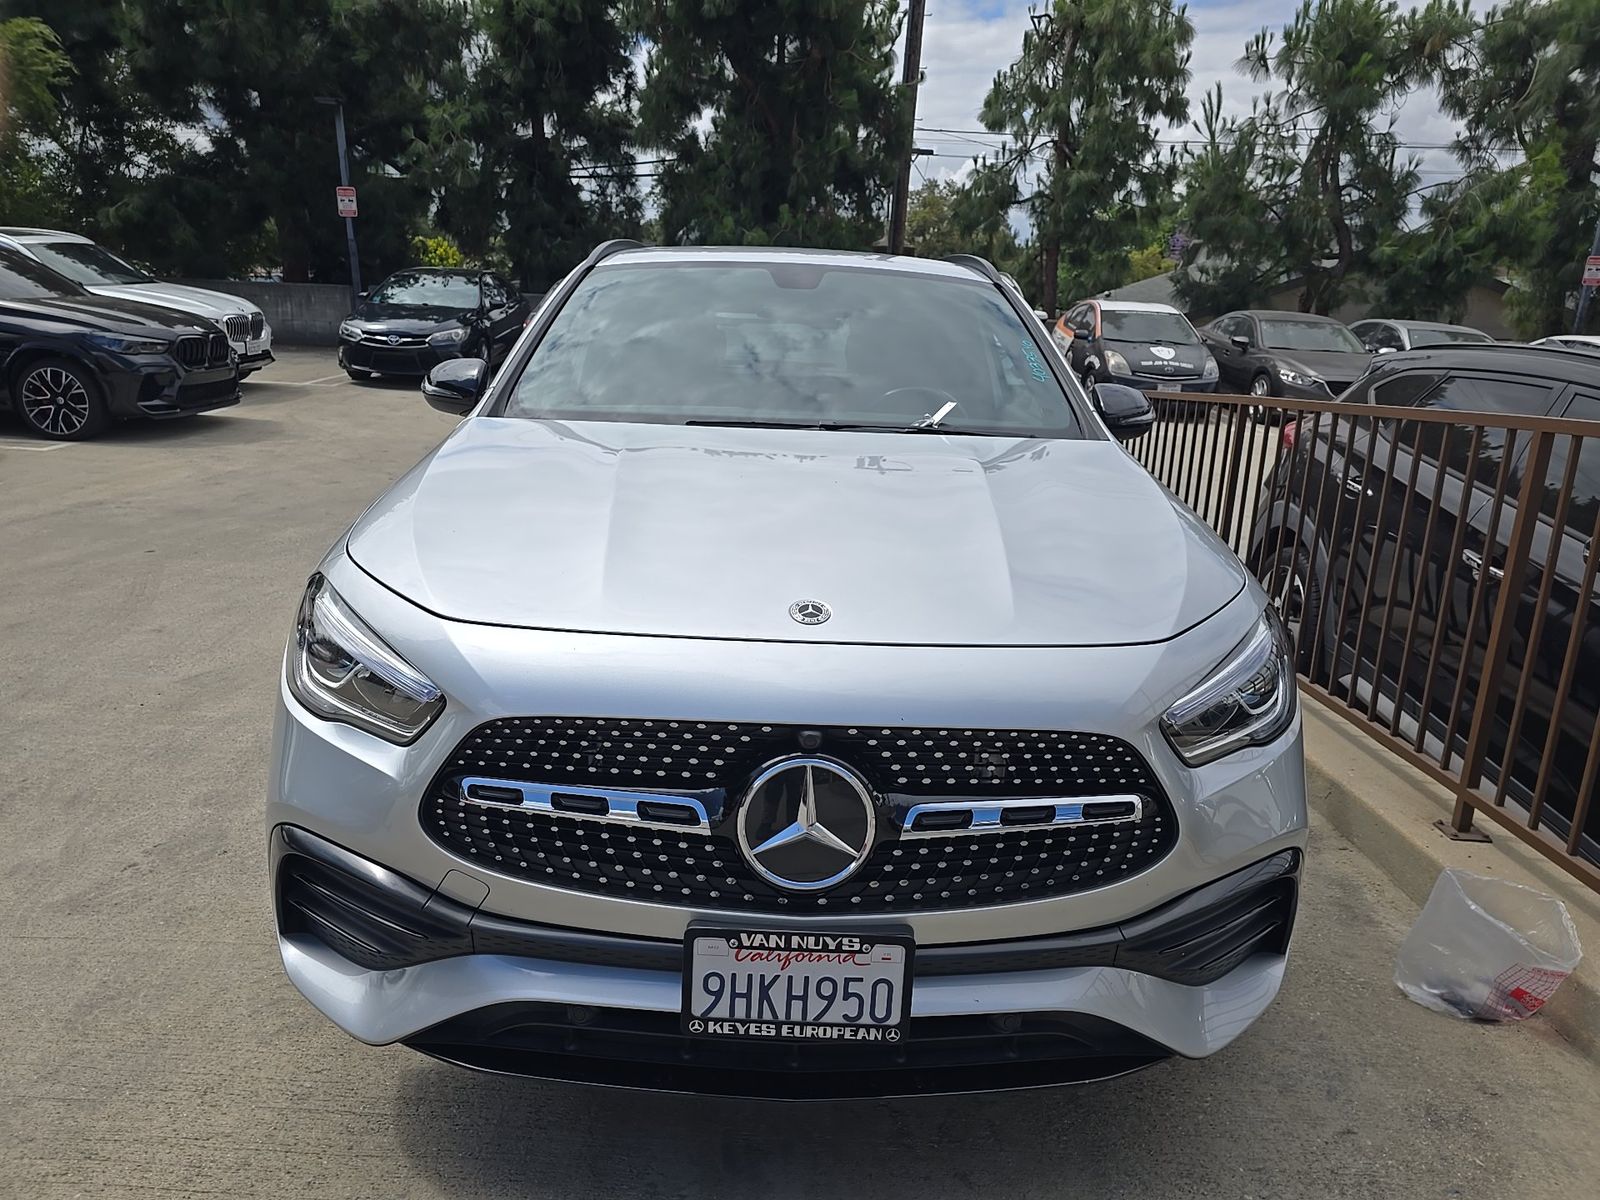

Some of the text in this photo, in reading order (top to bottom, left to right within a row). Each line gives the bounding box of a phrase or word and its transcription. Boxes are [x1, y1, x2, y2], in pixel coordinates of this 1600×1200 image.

[739, 932, 861, 951] VAN NUYS
[734, 948, 872, 971] California
[700, 971, 894, 1024] 9HKH950
[707, 1020, 883, 1041] KEYES EUROPEAN
